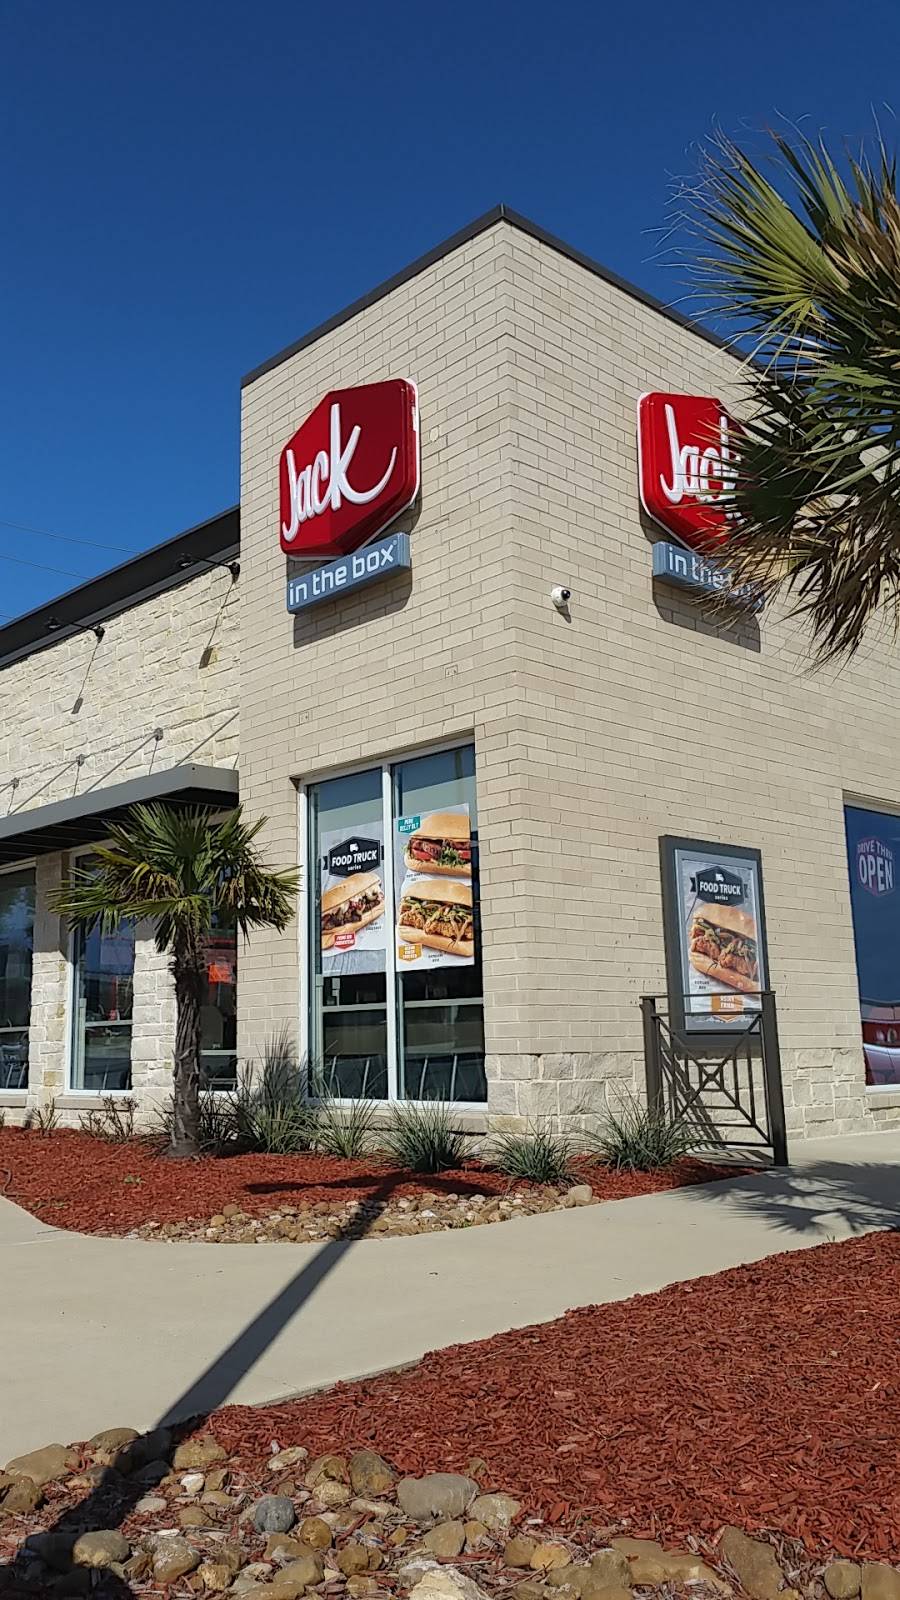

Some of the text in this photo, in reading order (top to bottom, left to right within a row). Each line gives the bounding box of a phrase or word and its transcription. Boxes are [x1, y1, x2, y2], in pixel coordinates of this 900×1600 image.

[282, 403, 398, 542] Jack
[289, 549, 394, 606] in the box
[669, 546, 687, 576] in
[331, 850, 378, 867] FOOD TRUCK
[859, 854, 894, 892] OPEN
[700, 881, 741, 896] FOOD TRUCK
